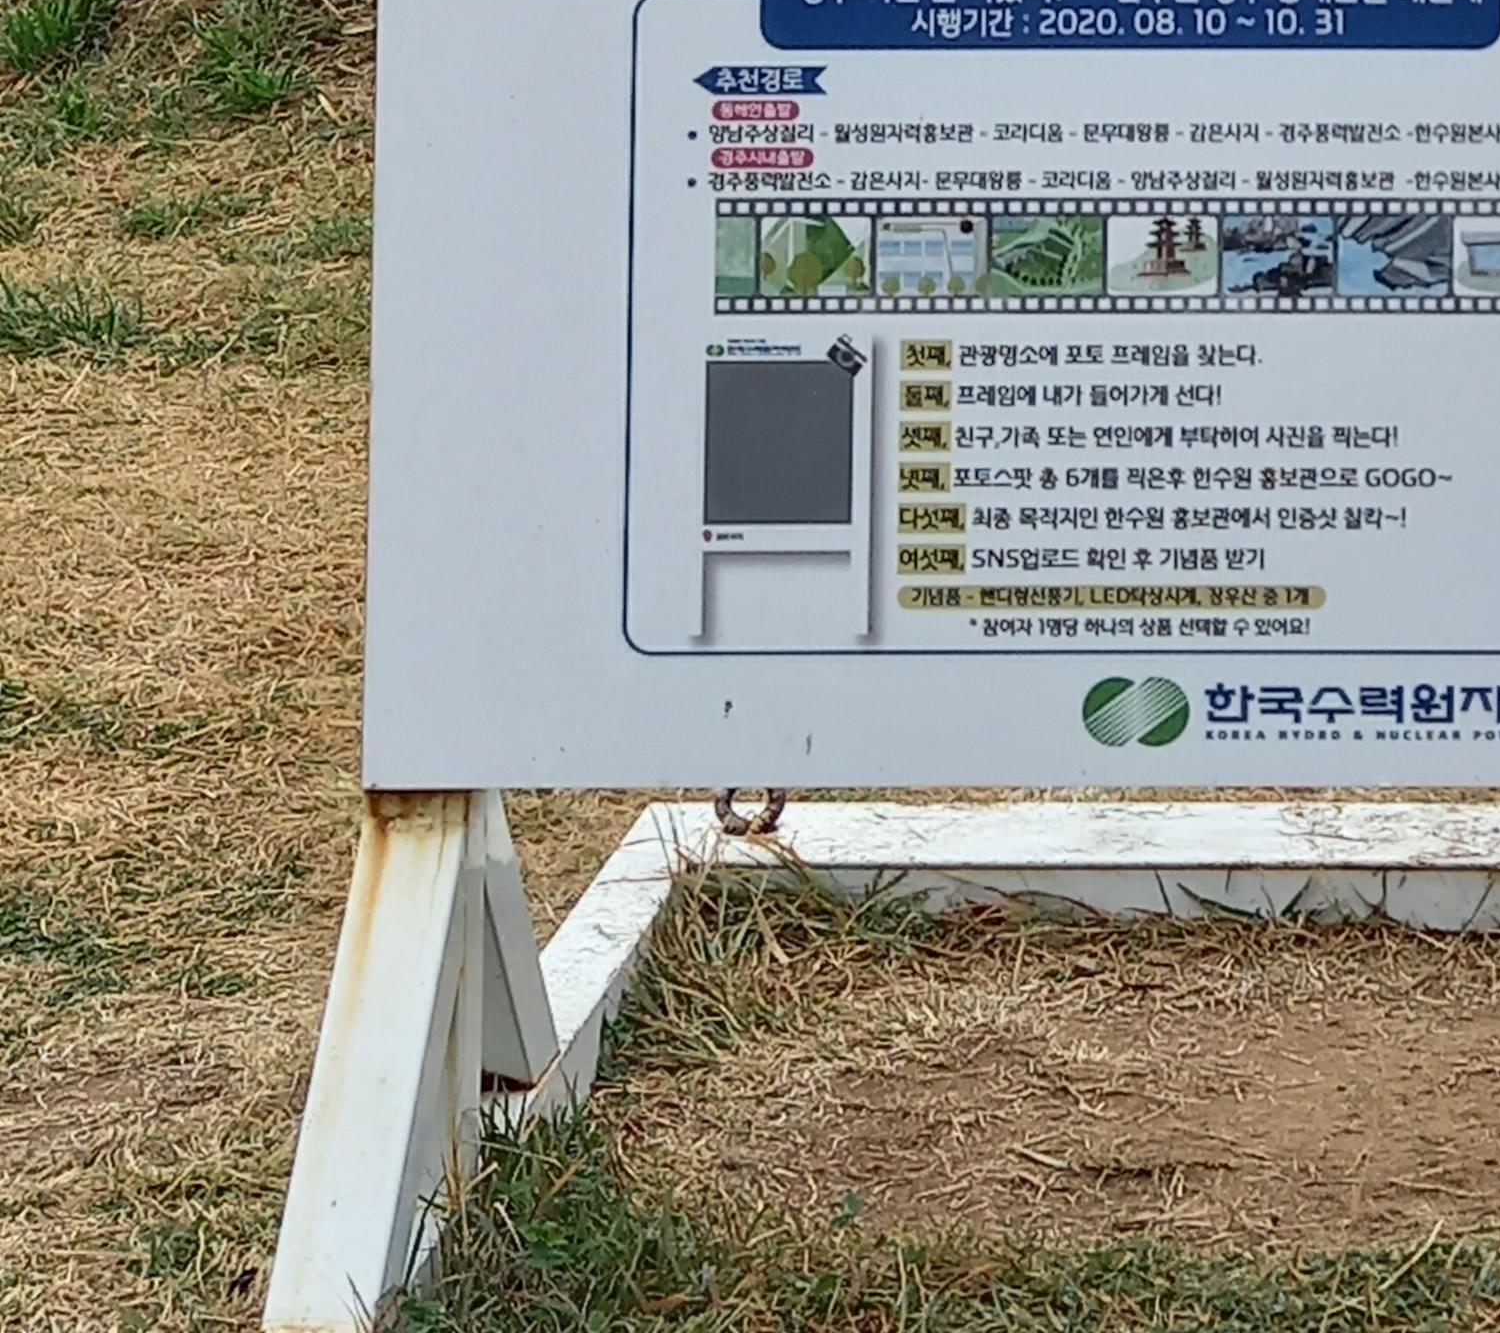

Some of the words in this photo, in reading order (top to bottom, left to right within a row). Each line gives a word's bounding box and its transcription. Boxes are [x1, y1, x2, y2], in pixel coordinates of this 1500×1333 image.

[911, 7, 1014, 39] 시행기간
[1038, 8, 1125, 36] 2020.
[1133, 8, 1184, 36] 08.
[1193, 8, 1227, 36] 10
[1264, 8, 1305, 36] 10.
[1315, 8, 1344, 35] 31
[715, 67, 805, 93] 추천경로
[905, 344, 952, 368] 첫째,
[959, 344, 1059, 368] 관광명소에
[1064, 344, 1104, 365] 포토
[1110, 344, 1190, 367] 프레임을
[1197, 344, 1262, 367] 찾는다.
[904, 385, 950, 408] 둘째,
[956, 384, 1037, 407] 프레임에
[1042, 384, 1083, 407] 내가
[1089, 384, 1169, 407] 들어가게
[1175, 384, 1222, 407] 선다!
[901, 426, 948, 450] 셋째,
[1047, 425, 1087, 449] 또는
[1092, 425, 1174, 448] 연인에게
[1265, 425, 1325, 449] 사진을
[1332, 425, 1398, 449] 찍는다!
[899, 468, 946, 491] 넷째,
[953, 467, 1033, 490] 포토스팟
[1065, 467, 1119, 490] 6개를
[1126, 467, 1186, 490] 찍은후
[1192, 466, 1252, 490] 한수원
[1259, 466, 1359, 491] 홍보관으로
[1364, 467, 1453, 488] GOGO~
[899, 507, 966, 531] 다섯째,
[972, 507, 1012, 530] 최종
[1019, 506, 1098, 530] 목적지인
[1103, 506, 1165, 530] 한수원
[1172, 506, 1271, 531] 홍보관에서
[1277, 507, 1337, 531] 인증샷
[899, 548, 965, 572] 여섯째,
[971, 548, 1080, 571] SNS업로드
[1086, 547, 1126, 571] 확인
[1132, 548, 1153, 571] 후
[1159, 548, 1219, 571] 기념품
[1225, 548, 1265, 571] 받기
[911, 587, 961, 607] 기념품
[1284, 587, 1310, 606] 1개
[983, 617, 1033, 638] 참여자
[1038, 617, 1079, 638] 1명당
[1084, 617, 1134, 637] 하나의
[1138, 617, 1173, 638] 상품
[1178, 617, 1229, 637] 선택할
[1233, 617, 1250, 637] 수
[1253, 617, 1311, 637] 있어요!
[1205, 730, 1266, 741] KOREA
[1278, 730, 1341, 741] HYDRO
[1375, 730, 1461, 741] NUCLEAR
